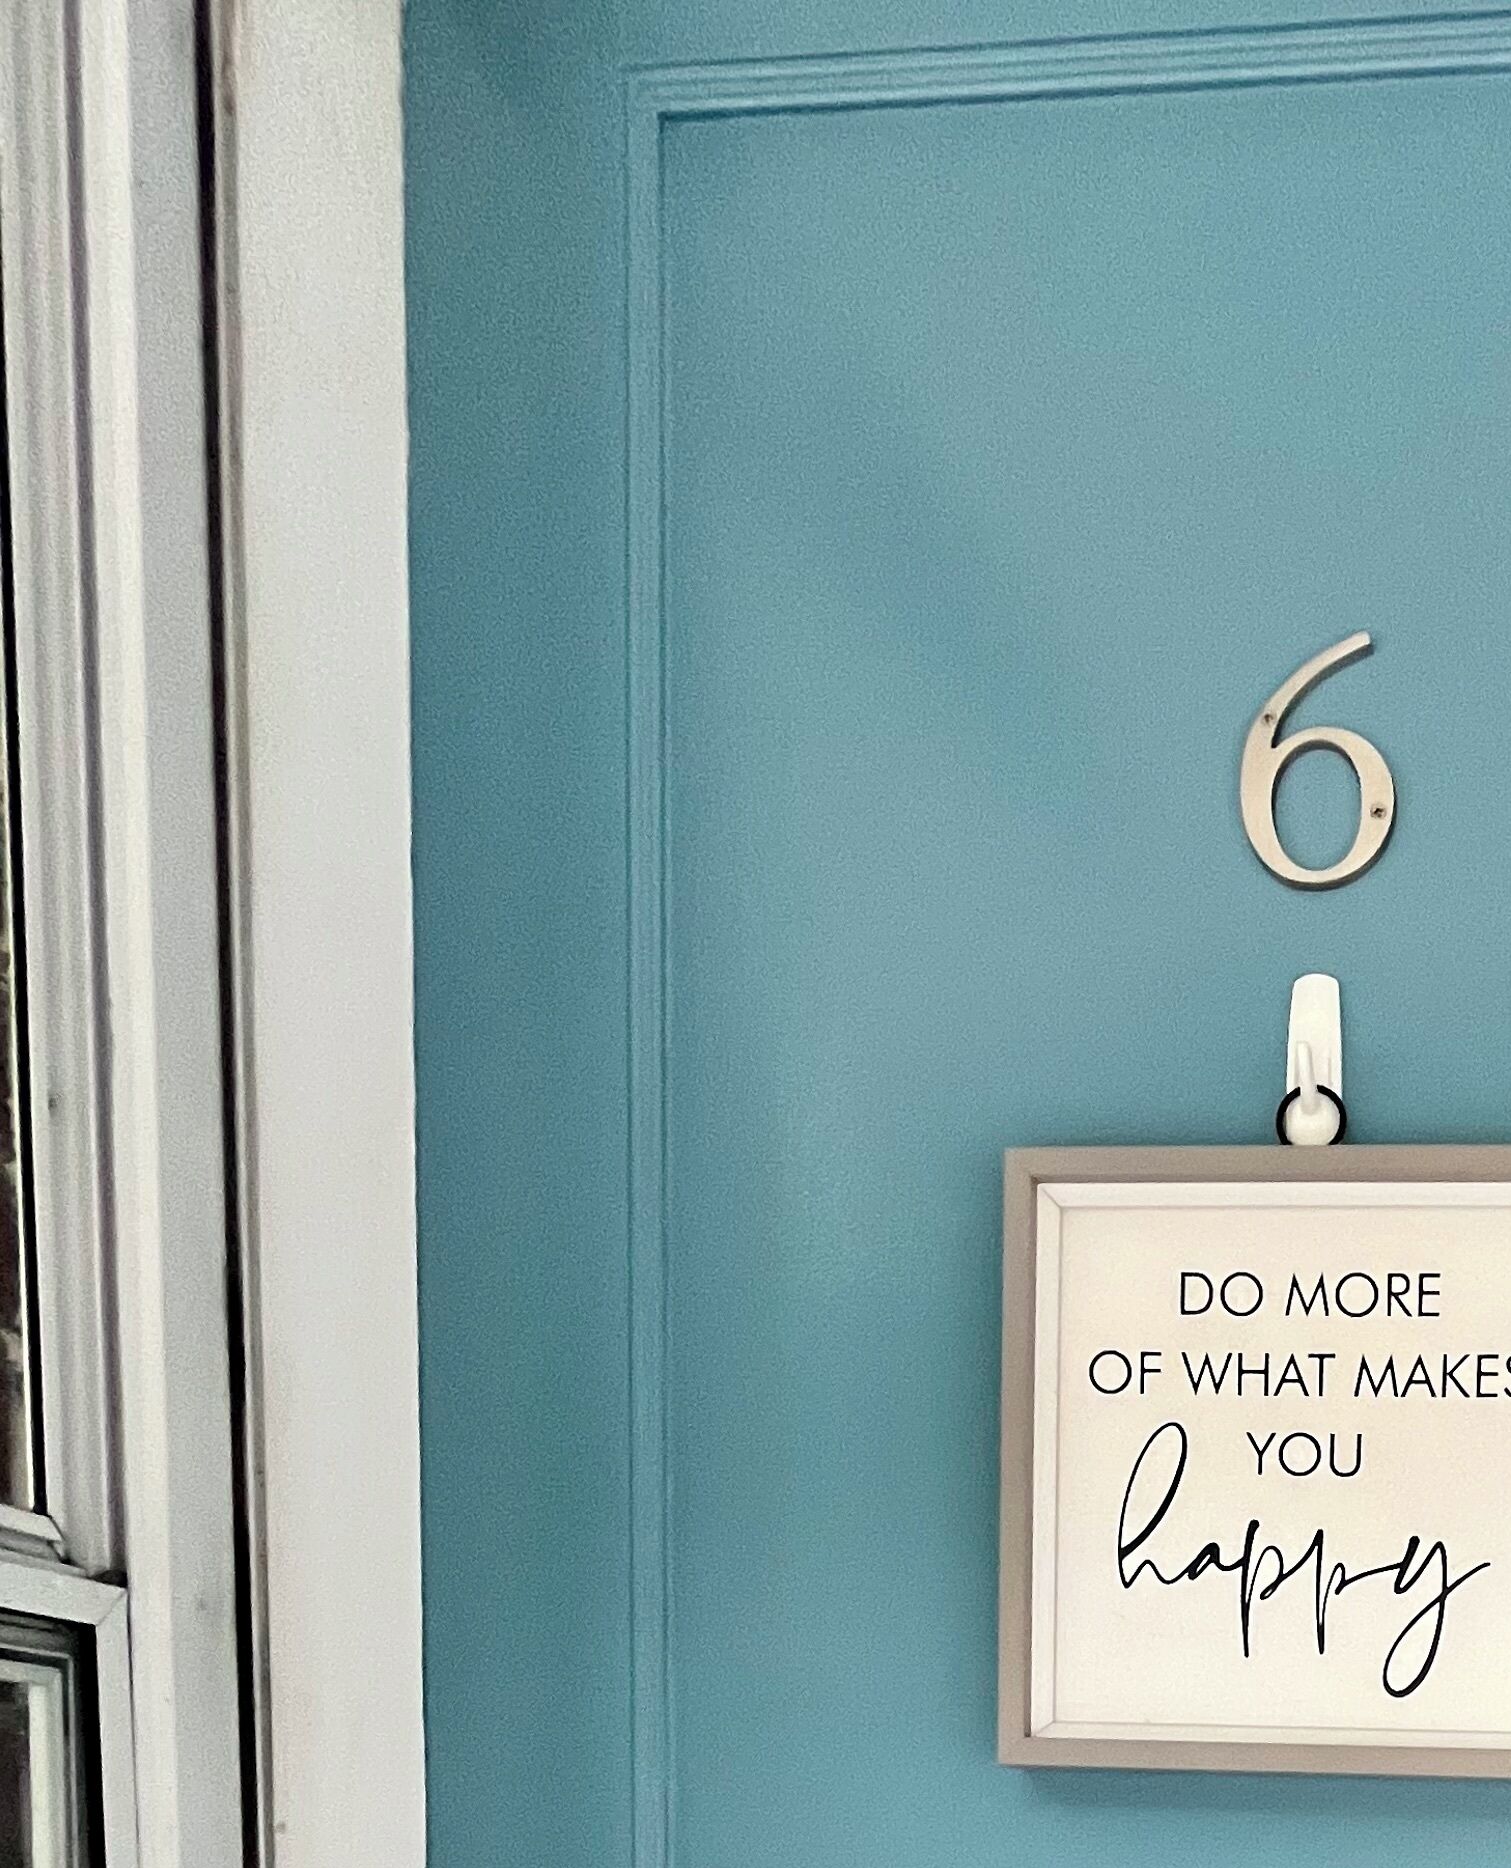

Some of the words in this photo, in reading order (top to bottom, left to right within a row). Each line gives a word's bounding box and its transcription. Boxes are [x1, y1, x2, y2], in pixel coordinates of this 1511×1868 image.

[1240, 630, 1396, 889] 6
[1180, 1271, 1264, 1317] DO
[1285, 1272, 1441, 1318] MORE
[1088, 1349, 1162, 1395] OF
[1181, 1351, 1336, 1398] WHAT
[1246, 1431, 1363, 1477] YOU
[1117, 1421, 1491, 1698] happy
